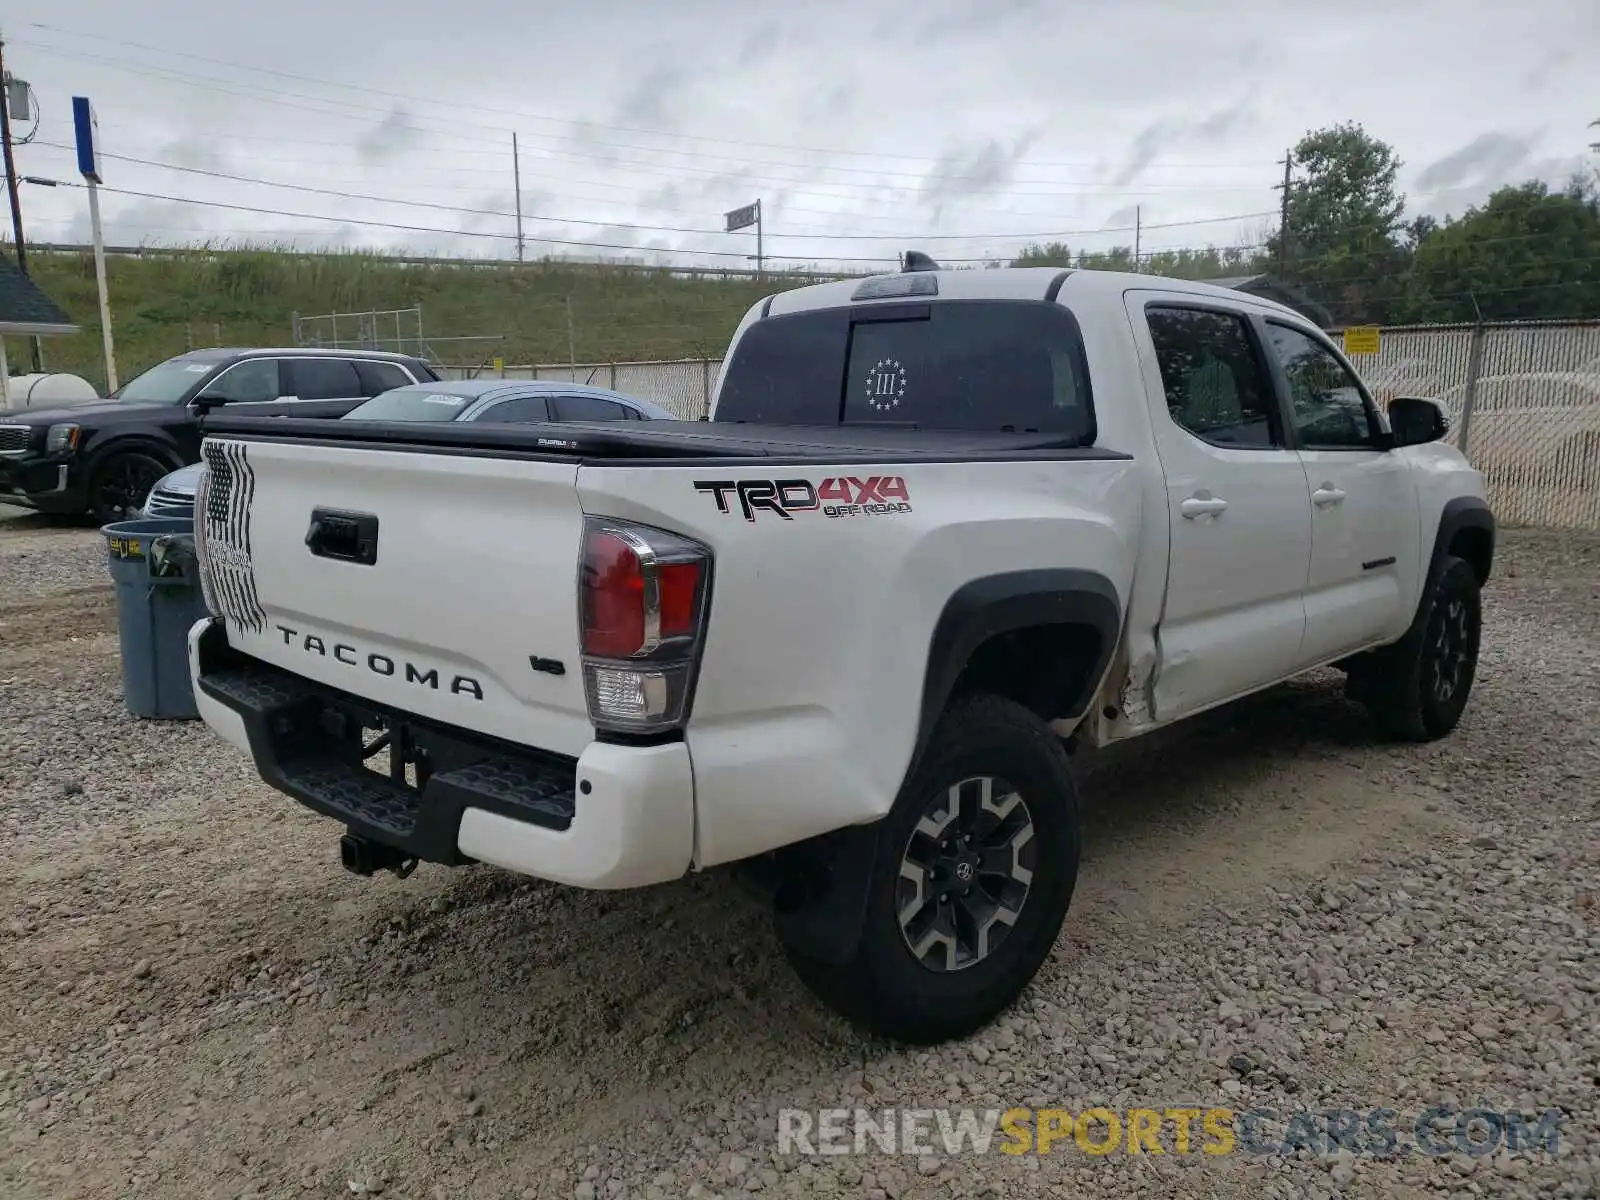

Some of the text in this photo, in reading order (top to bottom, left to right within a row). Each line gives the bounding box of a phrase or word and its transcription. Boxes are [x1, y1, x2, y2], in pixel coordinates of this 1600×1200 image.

[693, 476, 910, 522] TRD 4X4
[823, 502, 913, 518] OFF ROAD
[277, 624, 484, 701] TACOMA
